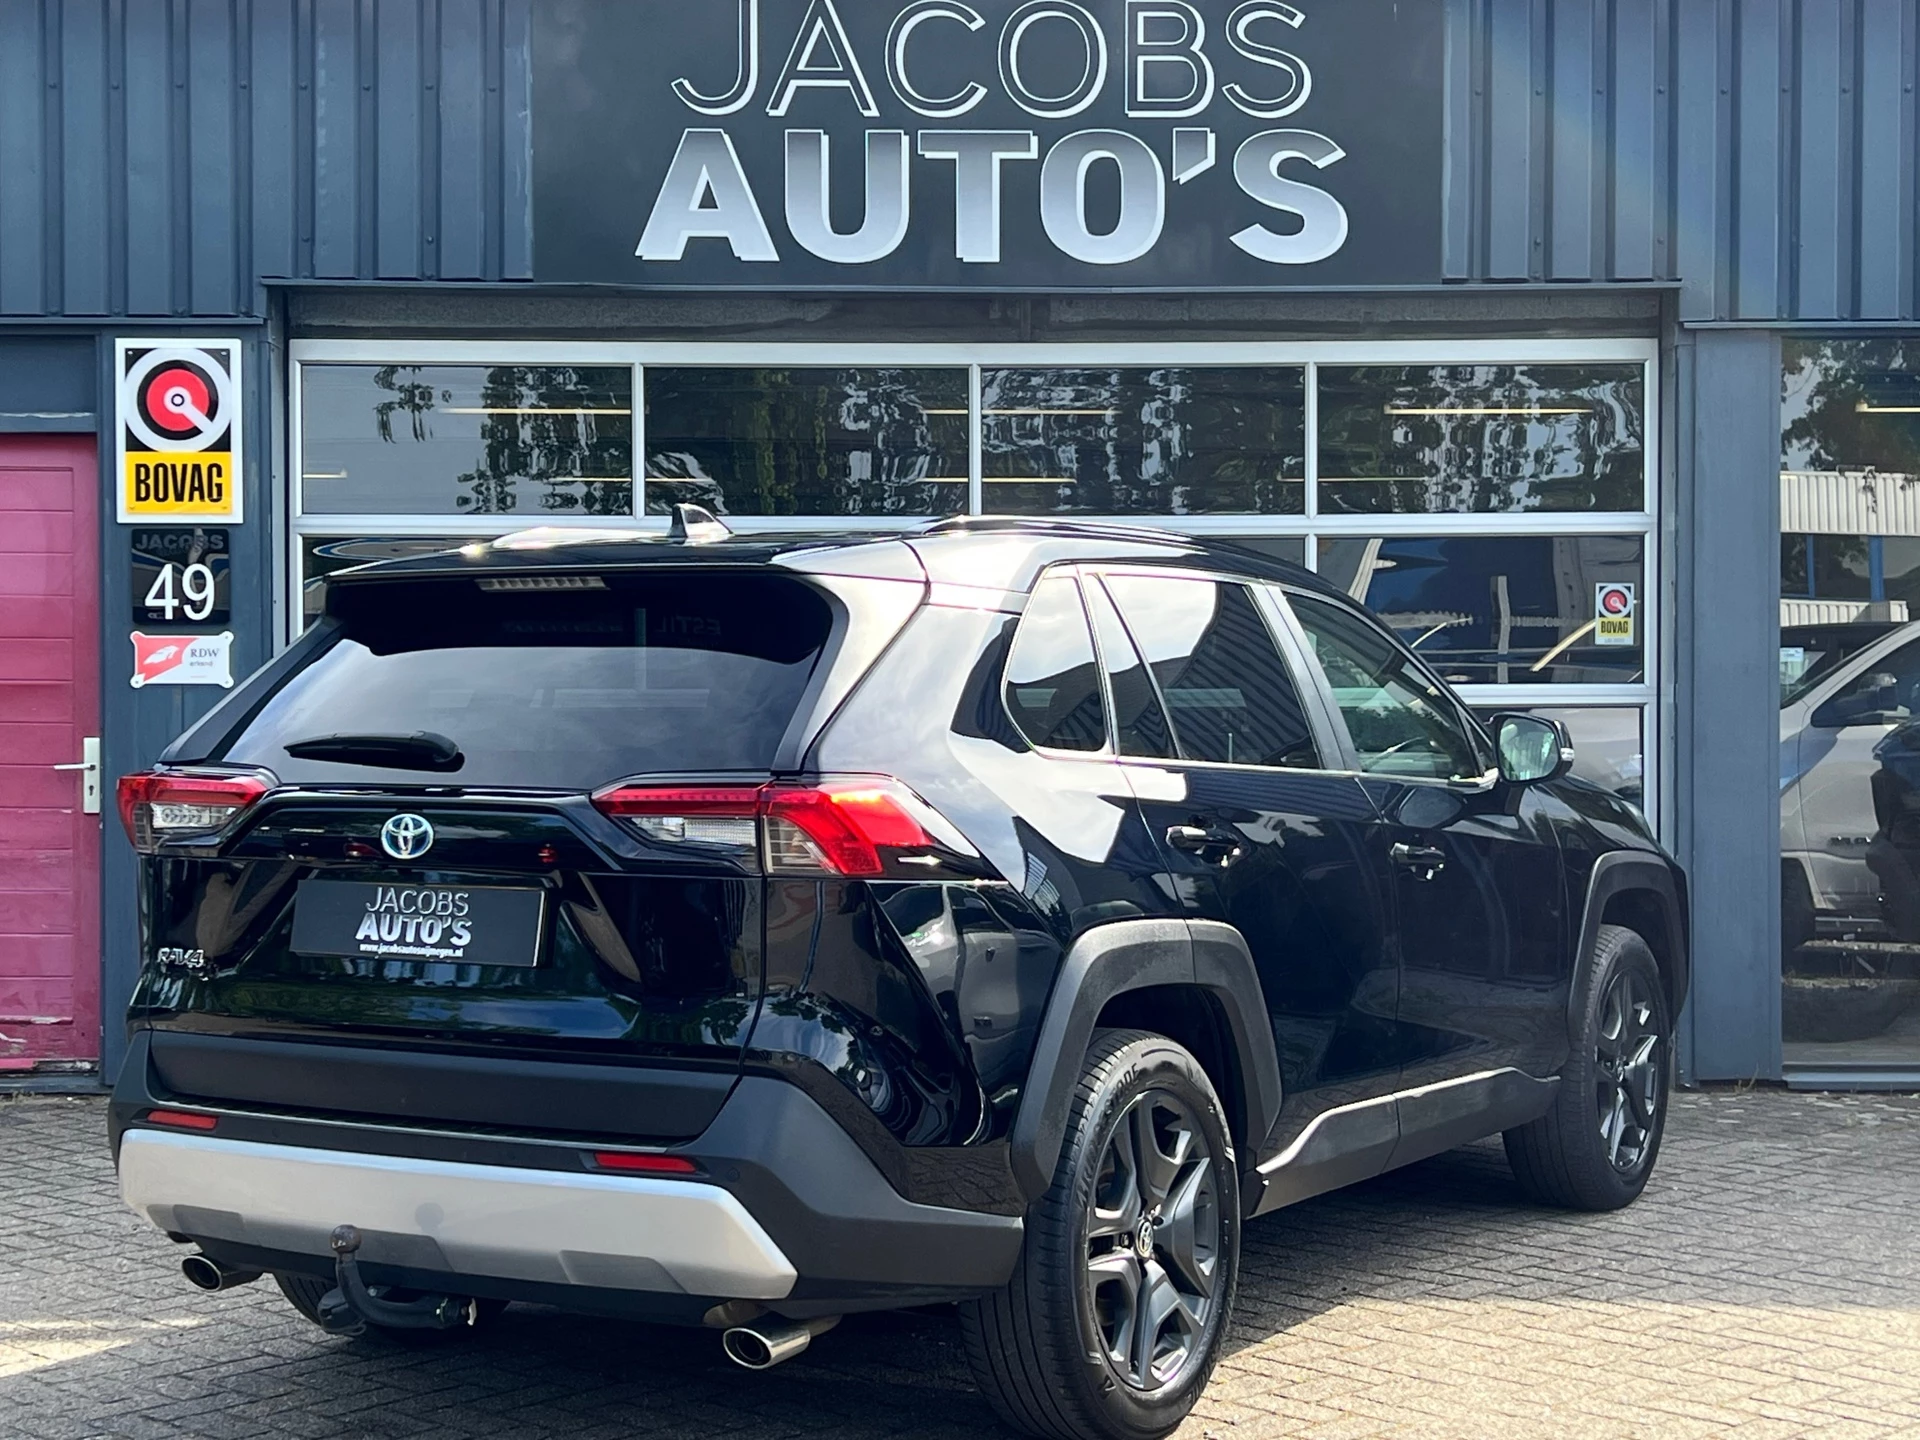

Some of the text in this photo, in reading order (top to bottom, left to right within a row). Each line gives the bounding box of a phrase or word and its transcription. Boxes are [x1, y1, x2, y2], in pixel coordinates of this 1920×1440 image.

[670, 0, 1313, 118] JACOBS
[634, 127, 1349, 264] AUTO'S
[134, 462, 223, 503] BOVAG
[135, 534, 224, 549] JACOBS
[144, 563, 216, 621] 49
[1601, 621, 1629, 633] BOVAG
[190, 647, 220, 658] RDW
[365, 886, 469, 917] JACOBS
[355, 912, 473, 947] AUTO'S
